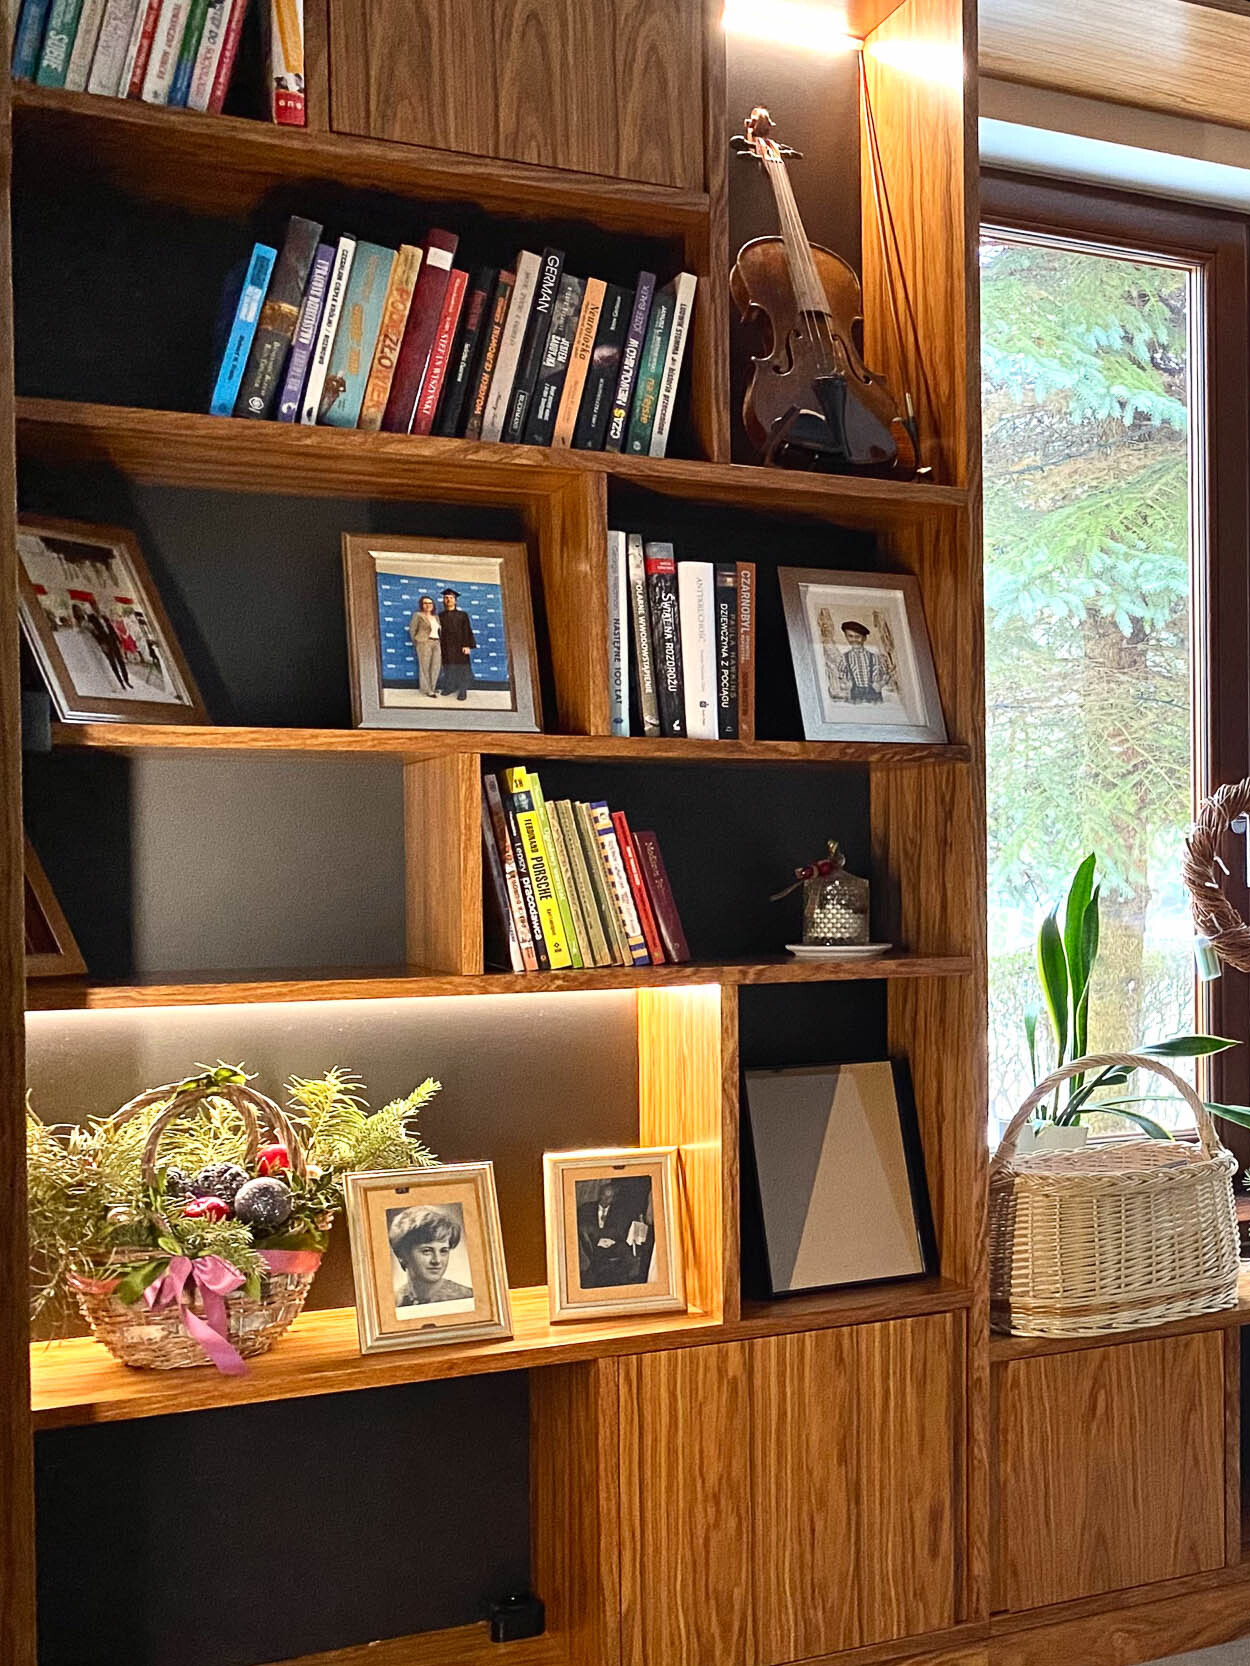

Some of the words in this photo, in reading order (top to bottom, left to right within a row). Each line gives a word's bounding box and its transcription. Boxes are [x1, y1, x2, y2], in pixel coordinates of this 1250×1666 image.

[536, 254, 560, 312] GERMAN
[676, 303, 686, 327] LUDWIK
[556, 337, 570, 362] JESTEM
[671, 328, 682, 355] STOMMA
[474, 372, 489, 414] WOJCIECH
[483, 325, 500, 371] CEJROWSKI
[610, 408, 625, 438] CZAS
[620, 338, 638, 406] NIEWOLNIKÓW
[646, 377, 655, 393] na
[638, 393, 654, 424] fejsie
[662, 593, 676, 621] ŚWIAT
[740, 570, 749, 633] CZARNOBYL
[663, 625, 672, 638] NA
[665, 642, 677, 691] ROZDROŻU
[719, 669, 728, 707] POCIĄGU
[524, 819, 537, 853] FERDINAND
[532, 856, 551, 901] PORSCHE
[515, 842, 526, 873] Lepszy
[522, 877, 542, 940] pracodawca
